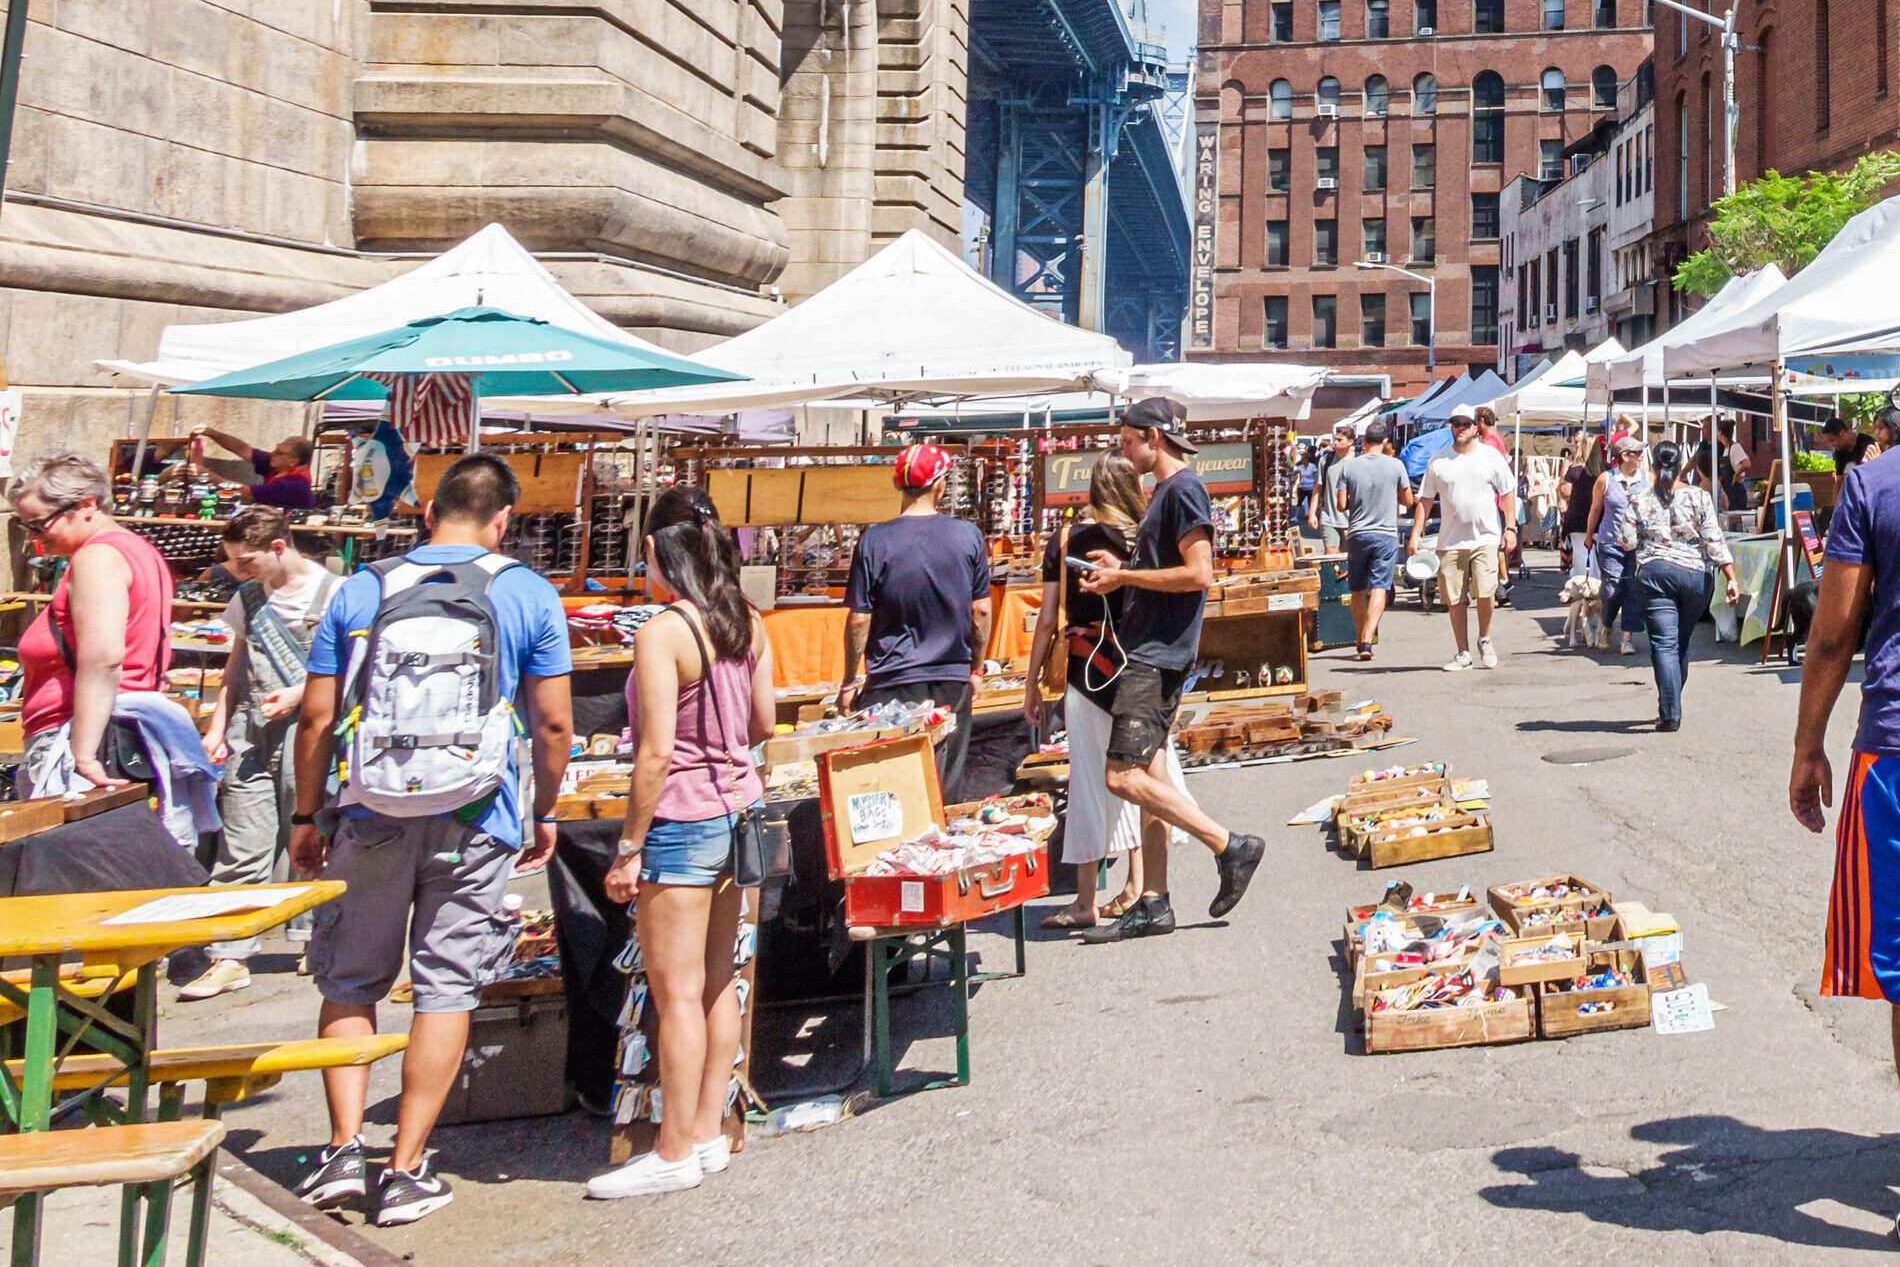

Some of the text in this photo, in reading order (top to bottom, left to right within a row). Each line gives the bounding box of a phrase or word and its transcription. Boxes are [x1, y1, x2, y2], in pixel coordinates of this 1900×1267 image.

[1194, 135, 1216, 335] WARING ENVELOPE
[425, 350, 573, 368] DUMBO
[851, 792, 895, 812] MYSTERY
